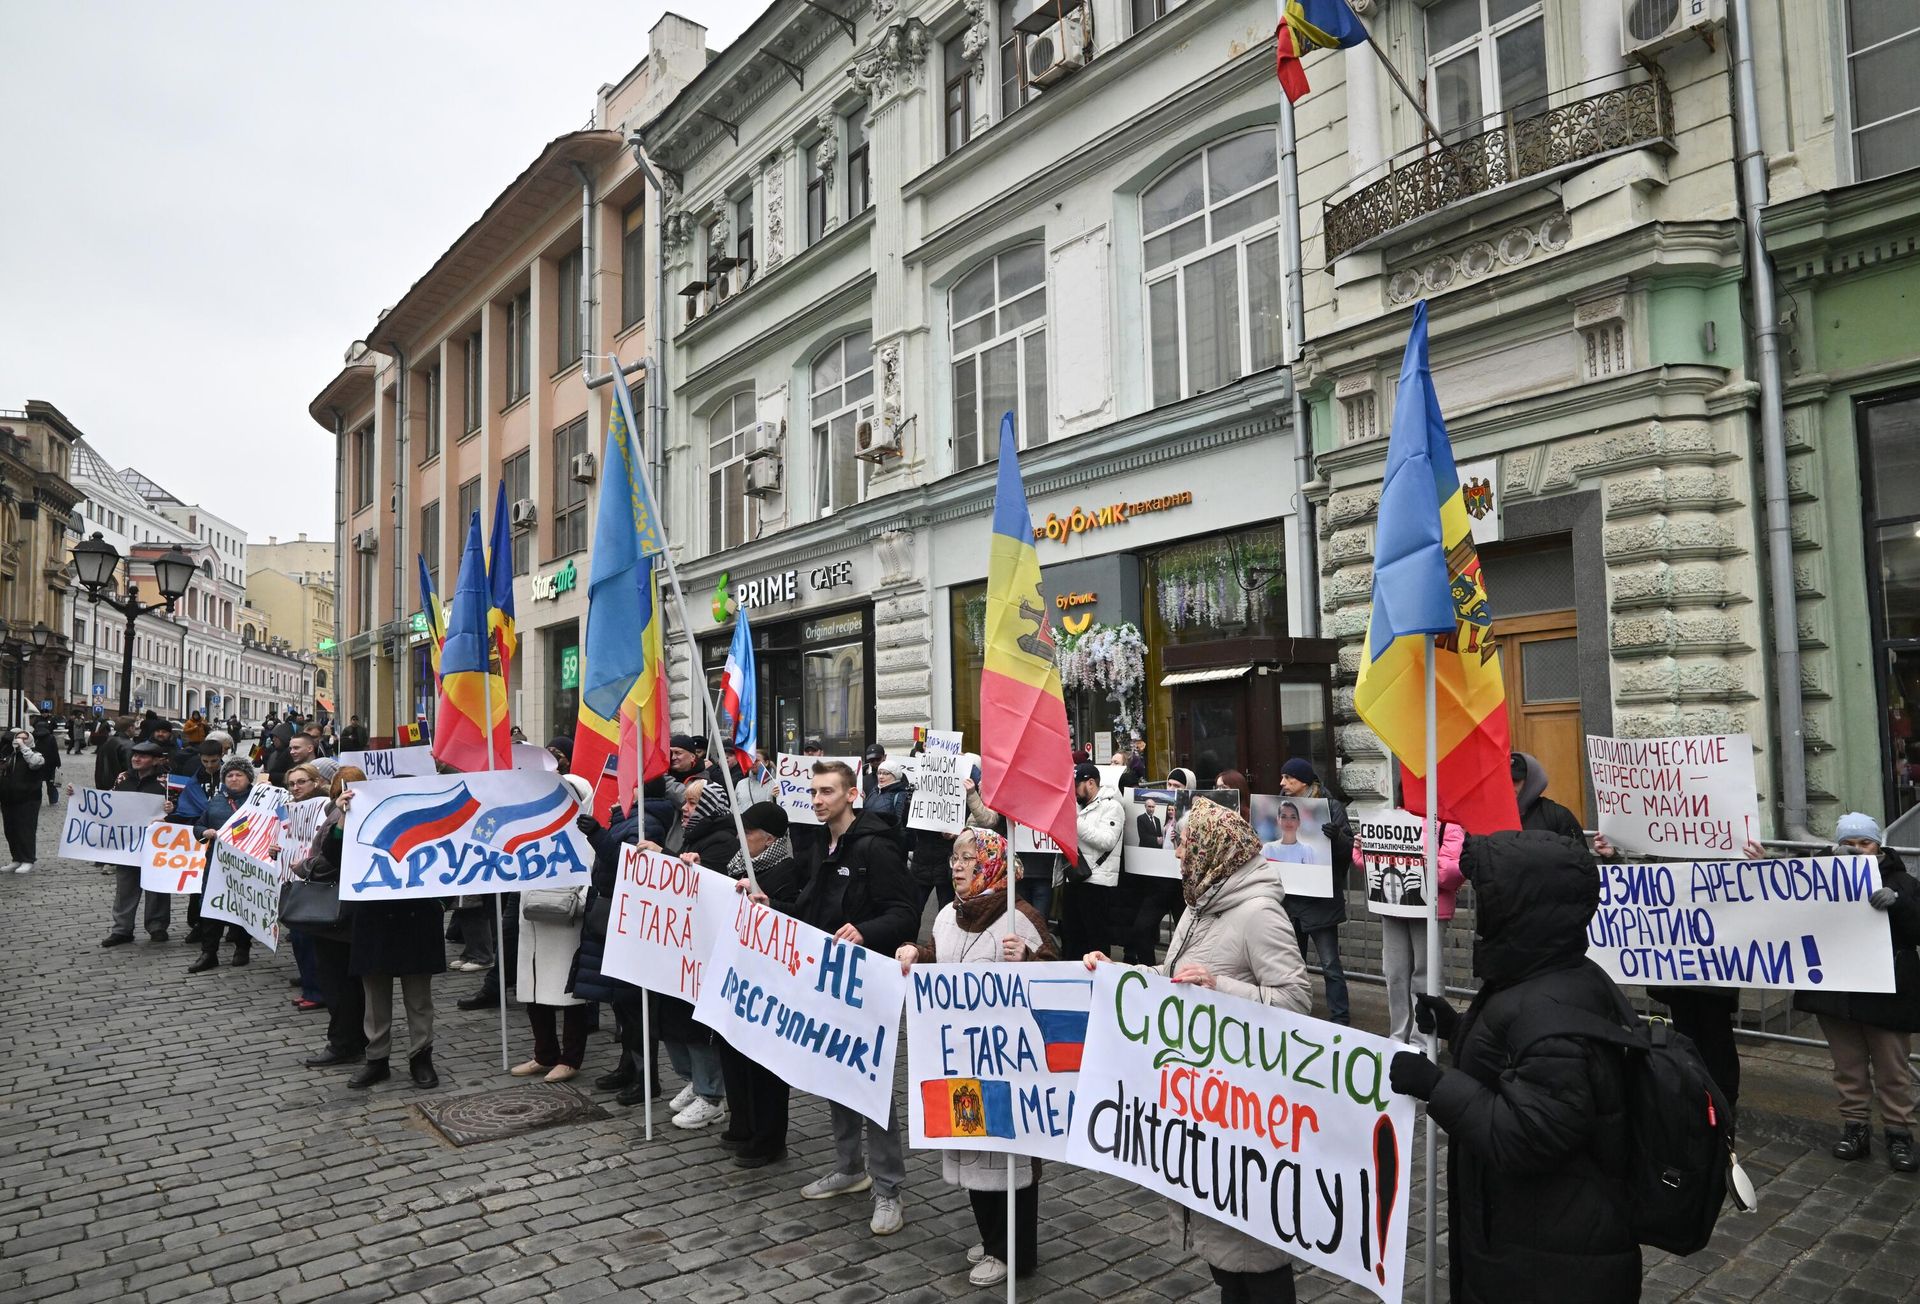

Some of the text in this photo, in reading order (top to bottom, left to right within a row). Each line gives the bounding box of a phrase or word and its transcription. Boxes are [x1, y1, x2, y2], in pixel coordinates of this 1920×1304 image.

[1128, 491, 1193, 516] пекарня
[738, 560, 852, 610] PRIME CAFE
[805, 616, 863, 641] Original recipes
[562, 656, 578, 680] 59
[1587, 737, 1729, 767] ПОЛИТИЧЕСКИЕ
[1592, 762, 1683, 792] РЕПРЕССИИ
[78, 788, 113, 819] JOS
[911, 800, 924, 818] НЕ
[1597, 789, 1710, 817] КУРС МАЙИ
[1360, 823, 1423, 844] СВОБОДУ
[351, 830, 588, 893] ДРУЖБА
[623, 848, 700, 903] MOLDOVA
[1690, 856, 1873, 904] АРЕСТОВАЛИ
[617, 893, 629, 935] E
[814, 936, 867, 1010] НЕ
[914, 972, 1028, 1014] MOLDOVA
[941, 1024, 958, 1076] E
[1114, 969, 1391, 1112] Gagauzia
